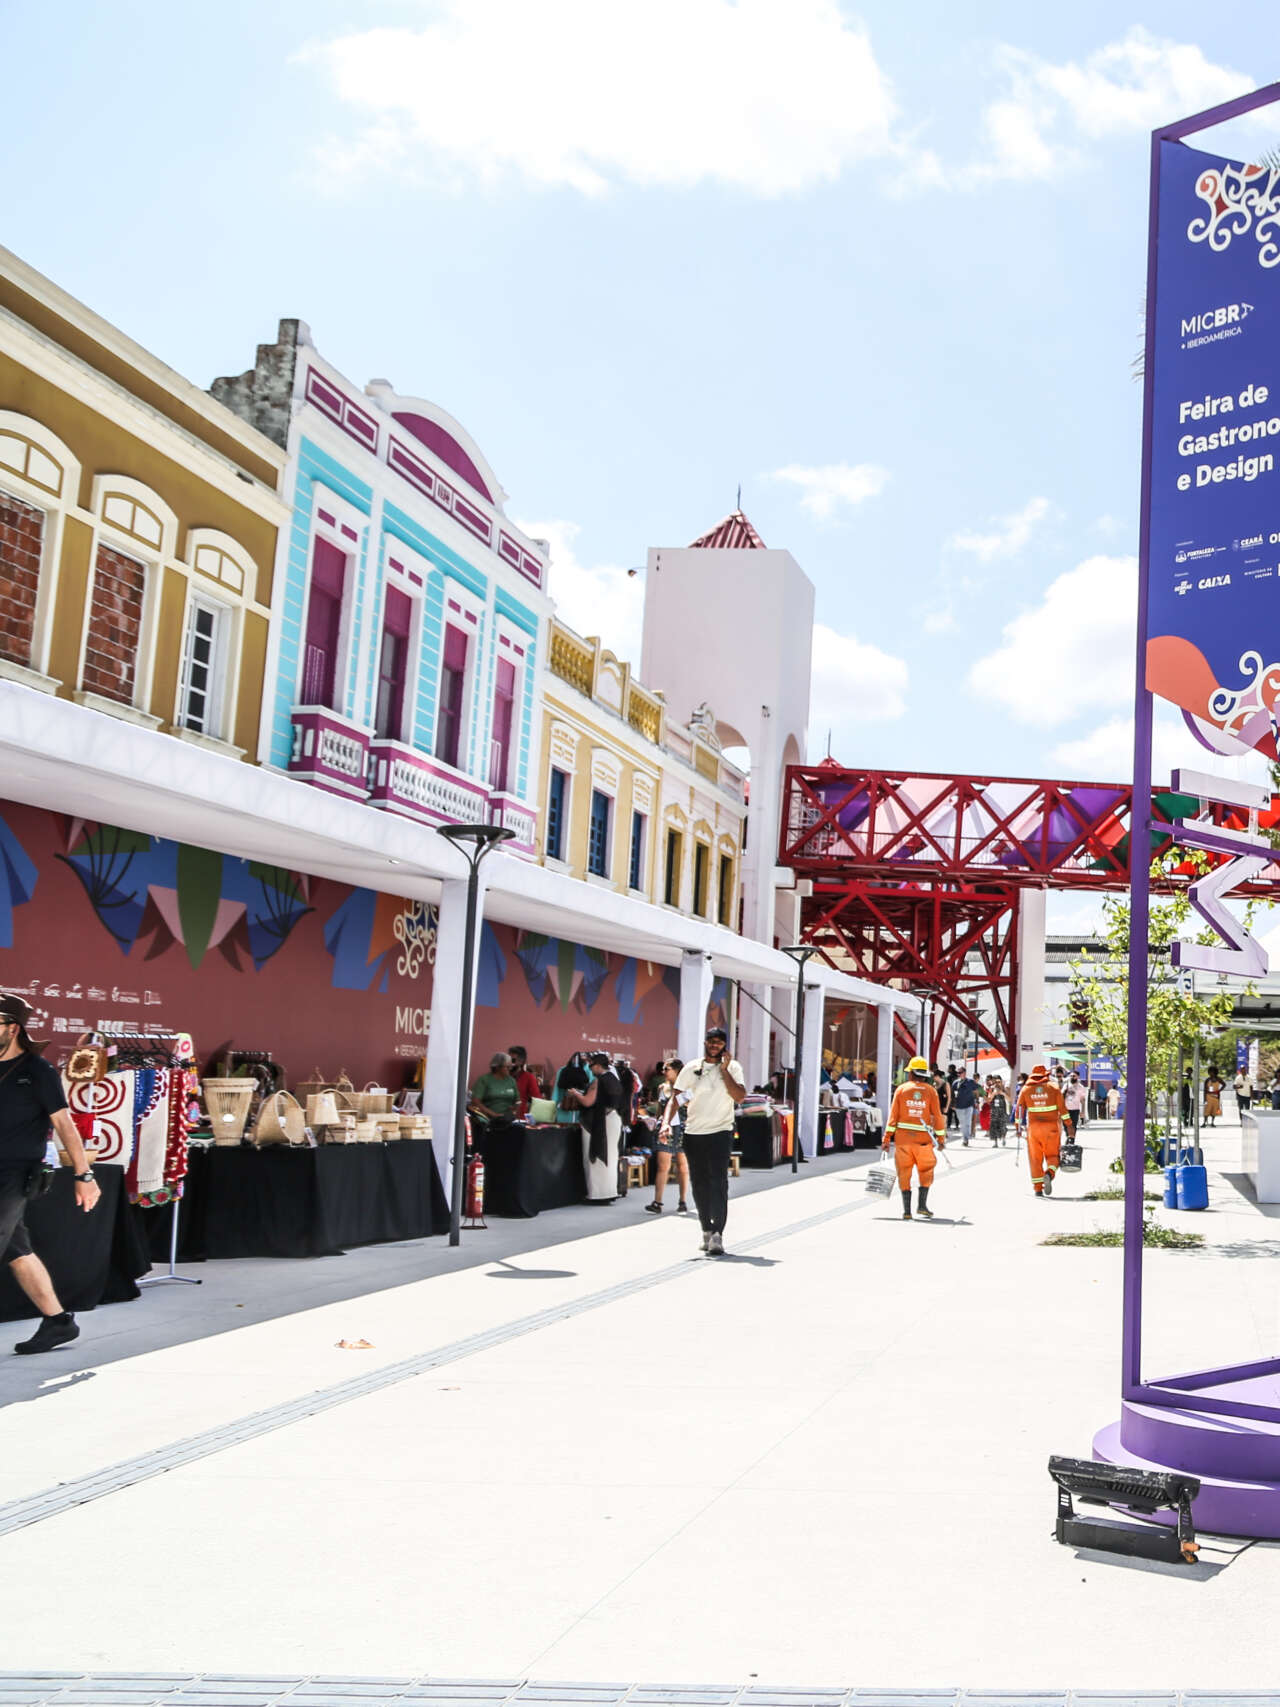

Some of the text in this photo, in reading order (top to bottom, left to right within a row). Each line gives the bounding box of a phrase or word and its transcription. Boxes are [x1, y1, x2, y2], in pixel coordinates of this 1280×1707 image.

[1181, 304, 1239, 337] MICBR
[1179, 384, 1269, 424] Feira de
[1177, 454, 1274, 491] e Design
[1198, 574, 1231, 590] CAIXA
